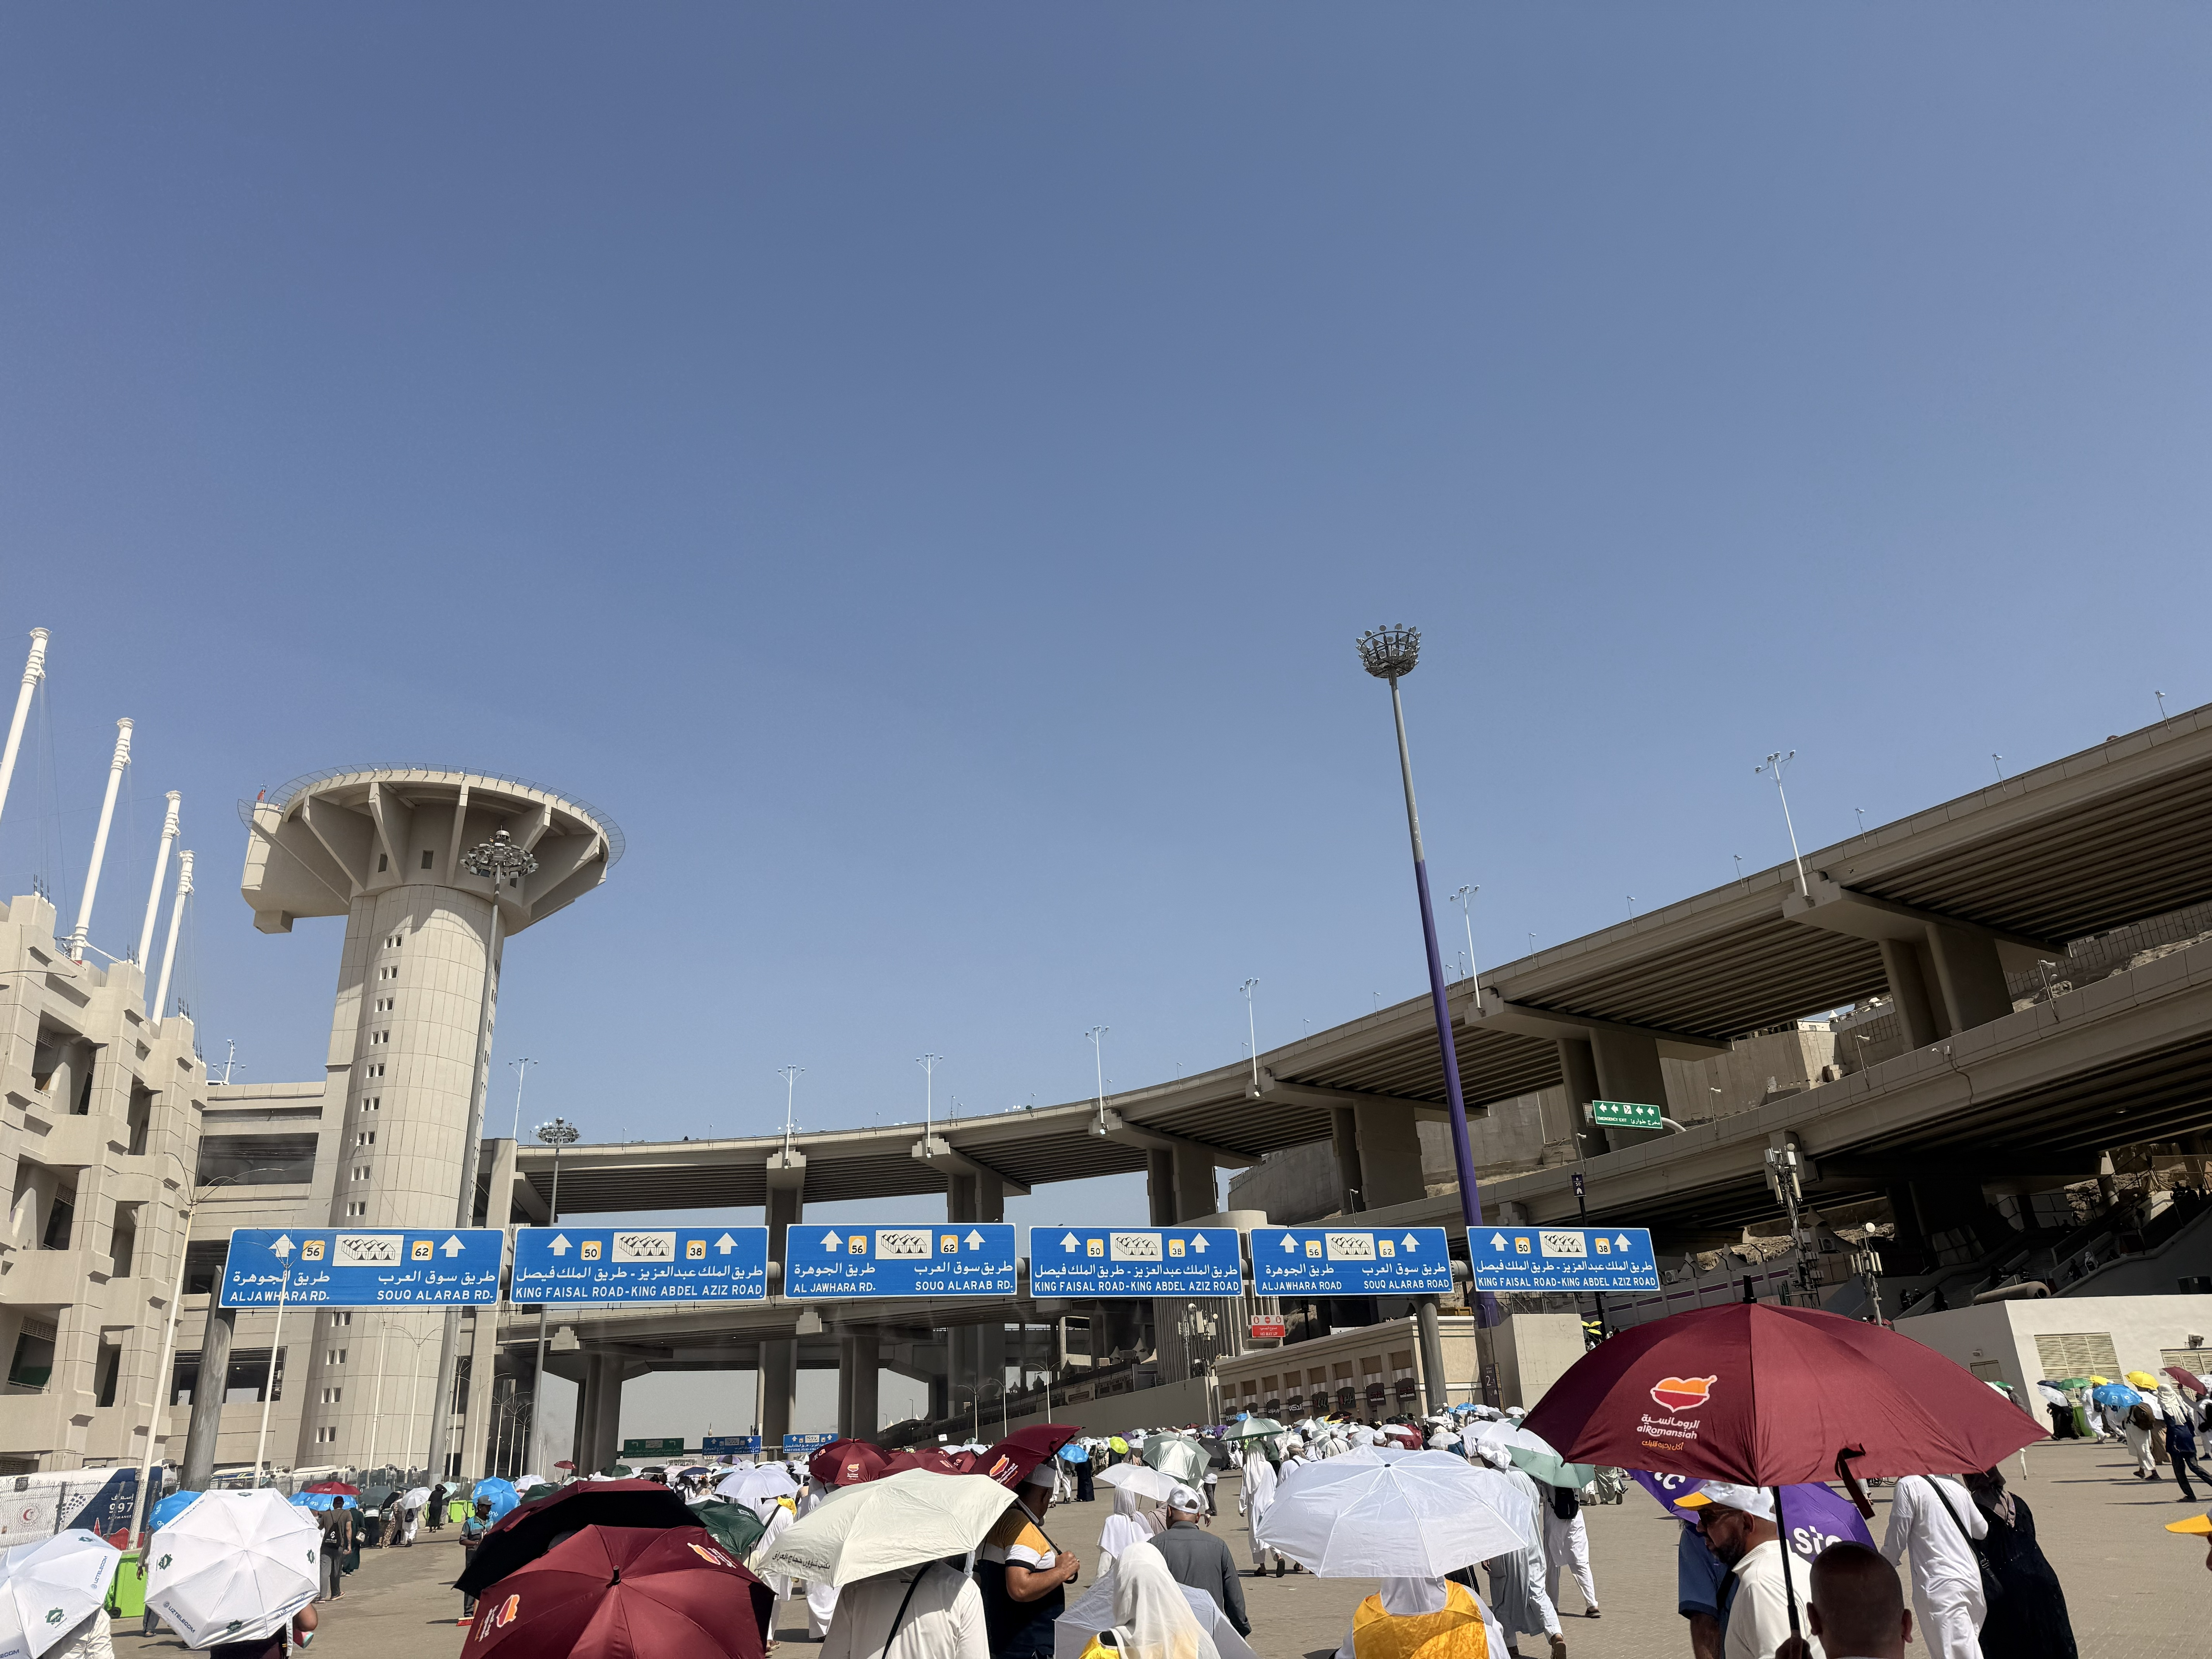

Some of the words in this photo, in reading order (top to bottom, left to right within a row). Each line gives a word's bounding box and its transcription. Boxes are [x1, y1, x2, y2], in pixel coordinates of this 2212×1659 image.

[307, 1247, 319, 1256] 56
[416, 1248, 429, 1257] 62
[584, 1249, 597, 1258] 50
[690, 1247, 702, 1257] 38
[852, 1245, 863, 1254] 56
[1518, 1244, 1528, 1252] 50
[698, 1265, 730, 1277] الملك
[795, 1262, 842, 1278] الجوهرة
[846, 1262, 875, 1277] طريق
[915, 1262, 950, 1275] العرب
[954, 1262, 980, 1274] سوق
[981, 1261, 1013, 1275] طريق
[1035, 1263, 1066, 1278] فيصل
[1068, 1264, 1095, 1275] الملك
[1097, 1265, 1124, 1278] طريق
[1133, 1264, 1182, 1278] عبدالعزيز
[1183, 1264, 1209, 1275] الملك
[1212, 1265, 1237, 1278] طريق
[1266, 1263, 1306, 1277] الجوهرة
[1309, 1264, 1334, 1277] طريق
[1362, 1263, 1392, 1276] العرب
[1396, 1263, 1418, 1275] سوق
[1422, 1262, 1446, 1275] طريق
[1477, 1260, 1504, 1273] فيصل
[1505, 1261, 1529, 1270] الملك
[1531, 1261, 1554, 1273] طريق
[1562, 1261, 1604, 1273] عبدالعزيز
[1606, 1261, 1628, 1271] الملك
[1630, 1261, 1652, 1273] طريق
[379, 1270, 421, 1285] العرب
[425, 1271, 457, 1284] سوق
[461, 1271, 495, 1285] طريق
[517, 1266, 555, 1281] فيصل
[557, 1267, 591, 1279] الملك
[594, 1267, 627, 1281] طريق
[637, 1266, 696, 1280] عبدالعزيز
[732, 1265, 763, 1279] طريق
[294, 1271, 330, 1286] طريق
[1364, 1280, 1385, 1289] SOUQ
[1427, 1279, 1449, 1288] ROAD
[1479, 1278, 1497, 1286] KING
[1500, 1278, 1531, 1286] FAISAL
[1583, 1278, 1609, 1286] ABDEL
[1613, 1278, 1631, 1286] AZIZ
[1633, 1277, 1655, 1285] ROAD
[516, 1287, 541, 1298] KING
[546, 1287, 587, 1297] FAISAL
[661, 1286, 697, 1296] ABDEL
[702, 1285, 728, 1295] AZIZ
[732, 1285, 761, 1295] ROAD
[793, 1284, 807, 1293] AL
[811, 1283, 856, 1292] JAWHARA
[859, 1282, 876, 1291] RD.
[915, 1281, 944, 1290] SOUQ
[998, 1281, 1013, 1289] RD.
[1035, 1282, 1056, 1291] KING
[1060, 1282, 1095, 1291] FAISAL
[1156, 1282, 1185, 1290] ABDEL
[1189, 1282, 1210, 1291] AZIZ
[1214, 1281, 1238, 1290] ROAD
[1319, 1281, 1341, 1290] ROAD
[310, 1291, 330, 1300] RD.
[377, 1290, 411, 1300] SOUQ
[475, 1290, 493, 1299] RD.
[1641, 1413, 1700, 1429] الرومانسية
[1637, 1422, 1697, 1439] alRomansiah
[109, 1502, 134, 1513] 997
[772, 1551, 788, 1561] العراق
[94, 1556, 108, 1583] UZTELECOM
[168, 1606, 195, 1633] UZTELECOM
